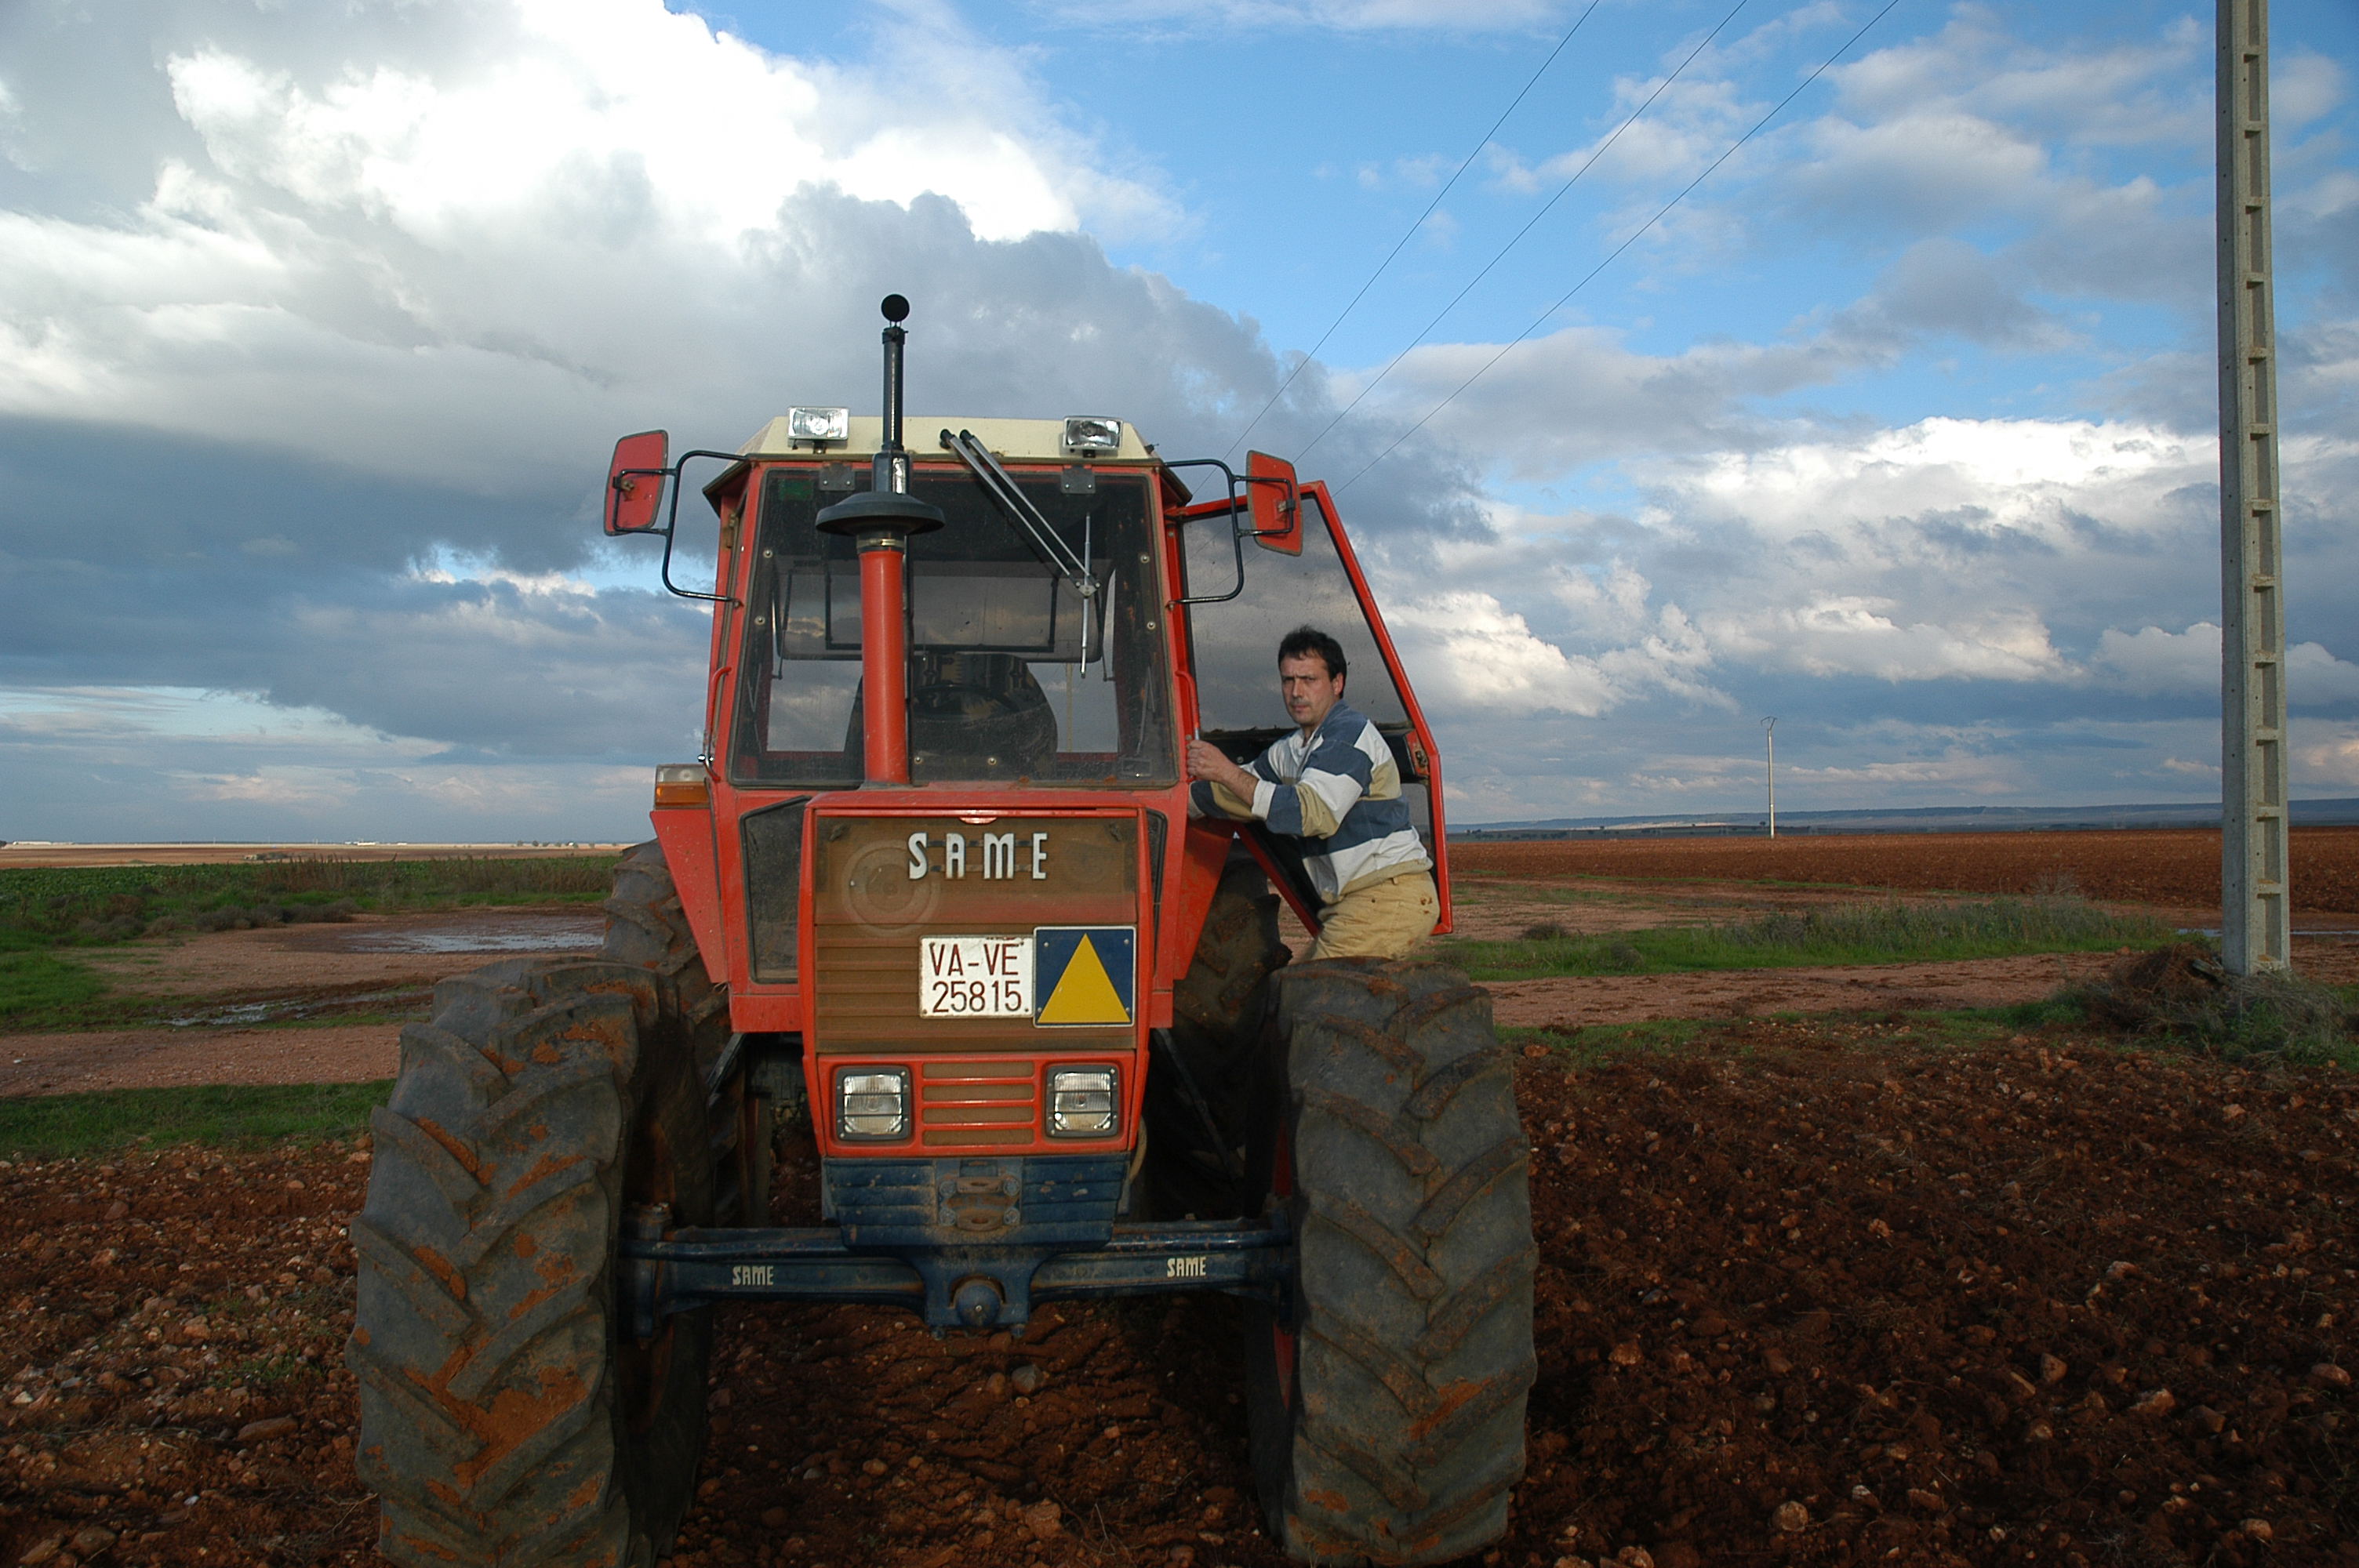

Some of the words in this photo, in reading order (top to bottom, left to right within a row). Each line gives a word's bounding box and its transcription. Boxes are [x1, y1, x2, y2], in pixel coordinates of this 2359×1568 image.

[908, 832, 1049, 880] SAME
[929, 943, 1020, 976] VA-VE
[932, 981, 1022, 1013] 25815
[732, 1265, 774, 1286] SAME
[1167, 1256, 1206, 1278] SAME
